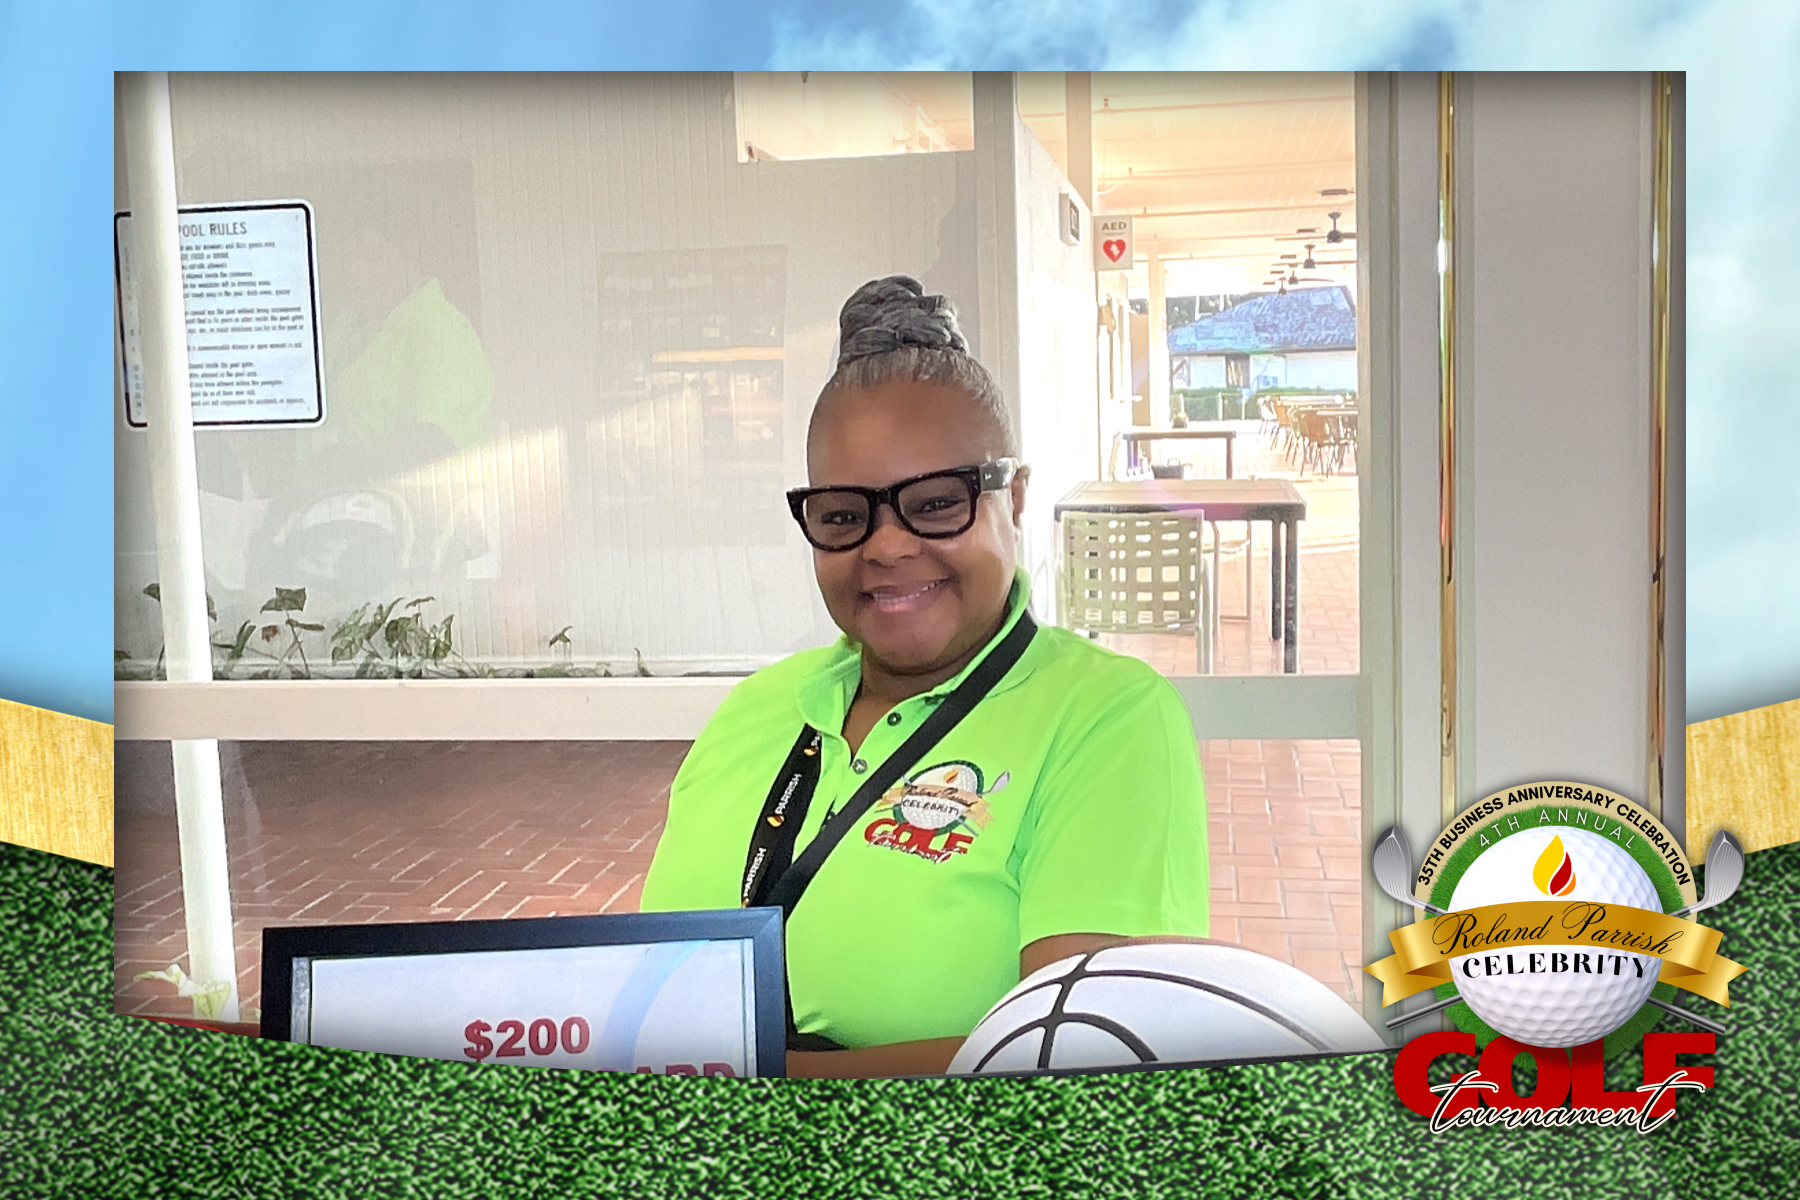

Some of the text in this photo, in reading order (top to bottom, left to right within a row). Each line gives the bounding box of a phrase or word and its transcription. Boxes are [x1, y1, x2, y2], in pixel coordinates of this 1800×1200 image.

[209, 222, 247, 235] RULES
[1101, 221, 1127, 231] AED
[774, 773, 802, 814] PARRISH
[865, 817, 974, 862] GOLF
[463, 1016, 591, 1063] $200
